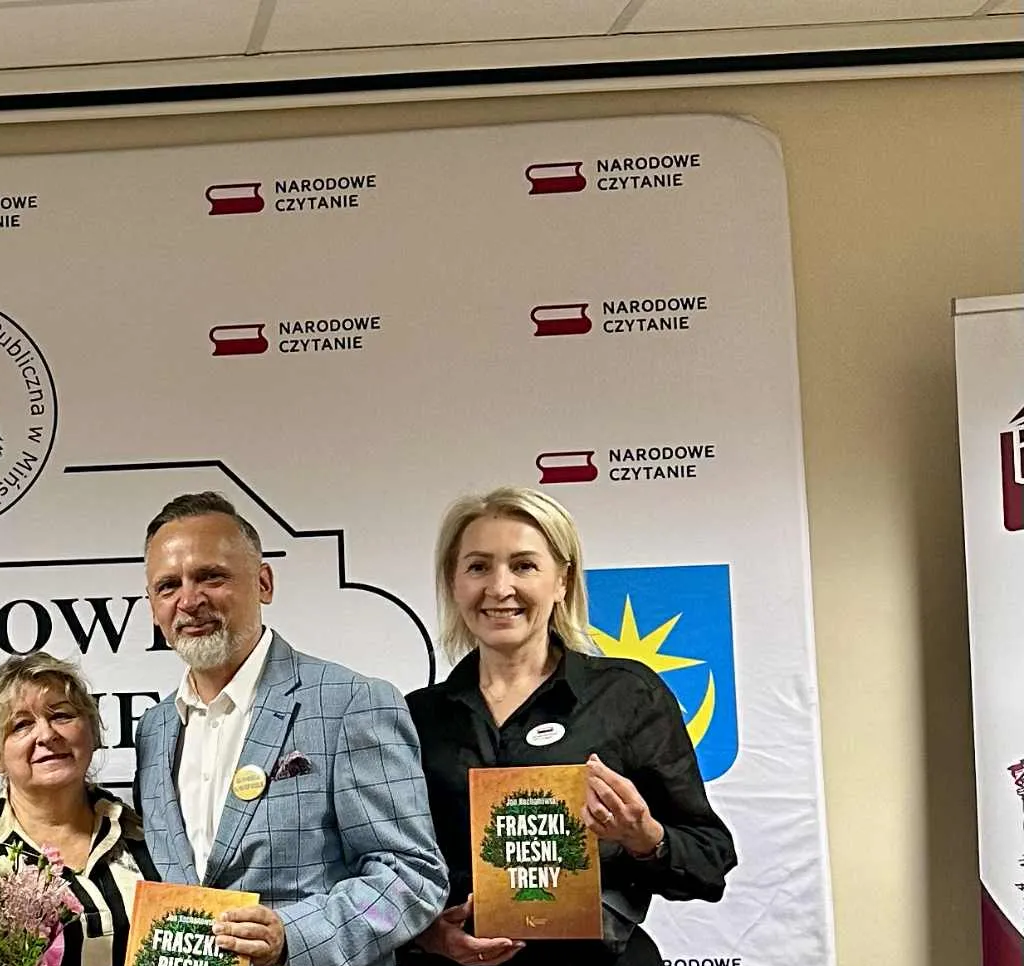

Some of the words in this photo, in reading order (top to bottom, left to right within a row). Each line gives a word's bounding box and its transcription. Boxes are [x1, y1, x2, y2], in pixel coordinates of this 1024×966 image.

[597, 154, 700, 172] NARODOWE
[276, 175, 376, 194] NARODOWE
[597, 173, 683, 190] CZYTANIE
[275, 195, 358, 212] CZYTANIE
[603, 297, 707, 315] NARODOWE
[280, 317, 380, 335] NARODOWE
[603, 317, 689, 333] CZYTANIE
[279, 336, 362, 353] CZYTANIE
[28, 426, 44, 443] w
[610, 445, 715, 462] NARODOWE
[610, 465, 696, 481] CZYTANIE
[496, 814, 570, 836] FRASZKI,
[505, 837, 562, 863] PIEŚNI,
[508, 866, 560, 889] TRENY
